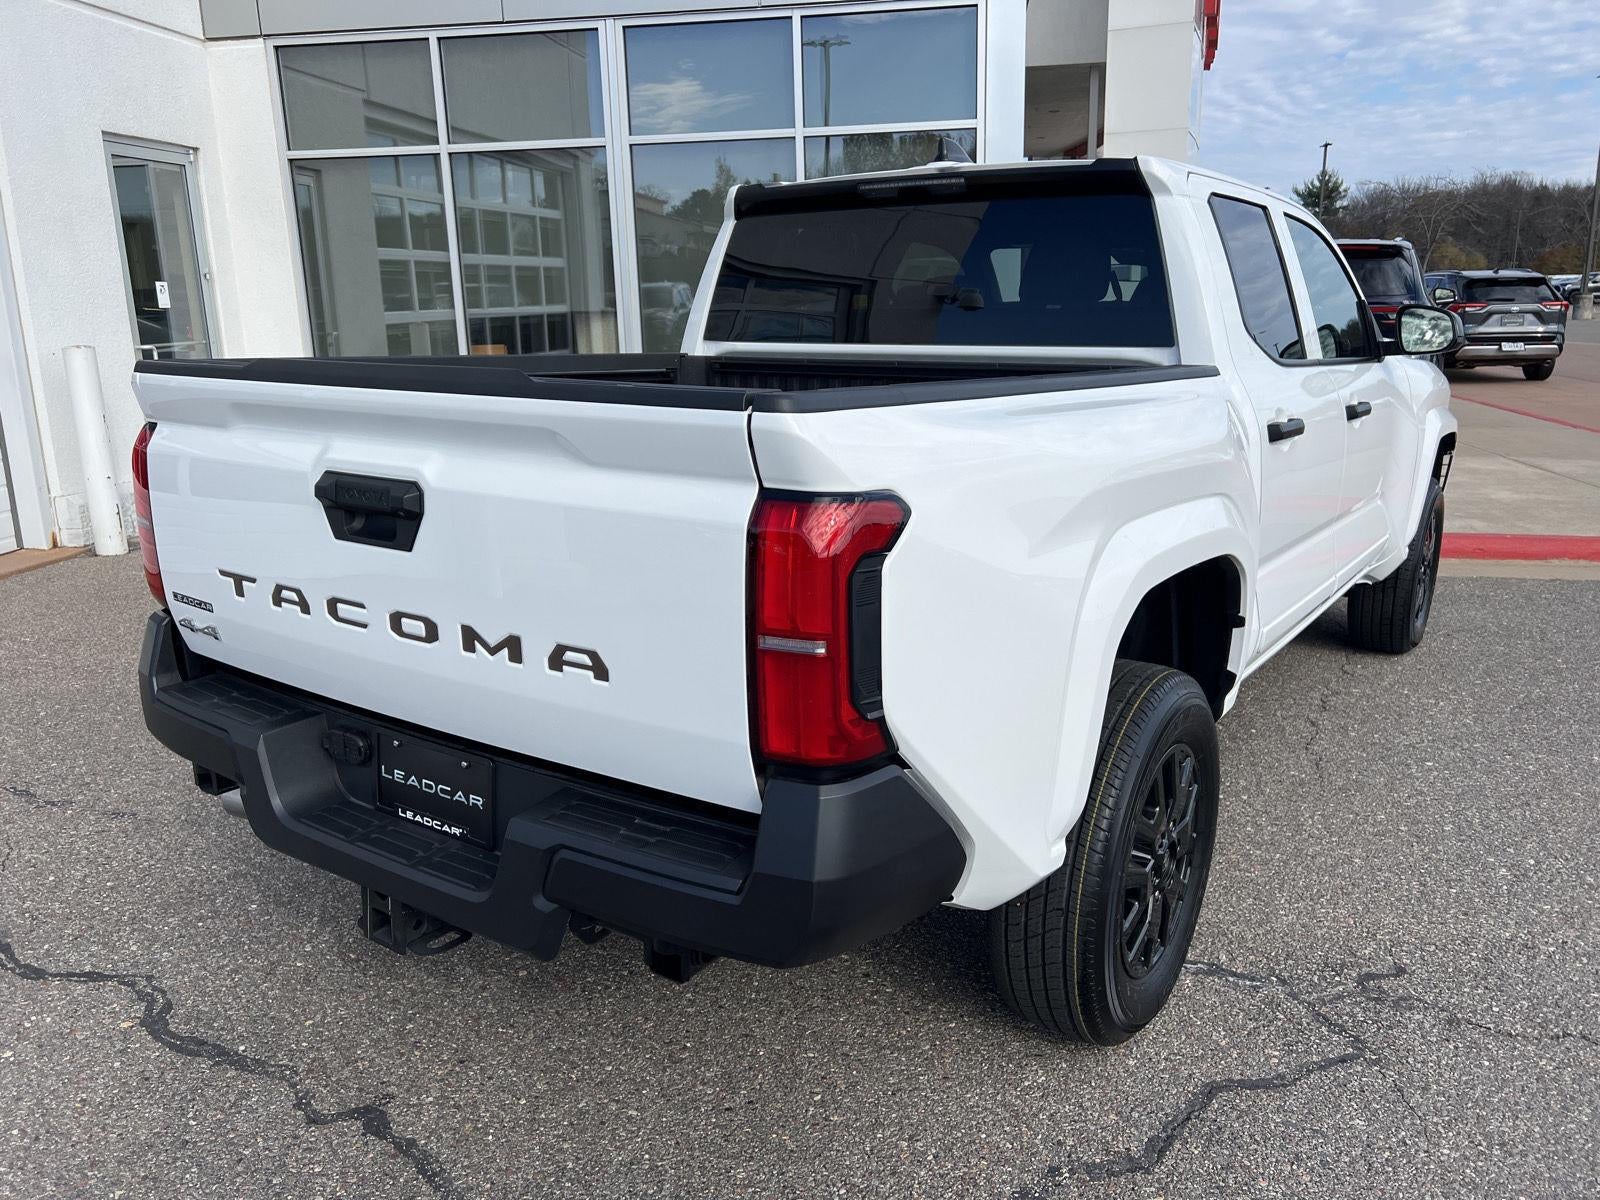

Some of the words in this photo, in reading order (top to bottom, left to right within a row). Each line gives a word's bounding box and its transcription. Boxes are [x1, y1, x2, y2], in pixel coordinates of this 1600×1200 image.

[217, 568, 610, 682] TACOMA
[381, 764, 484, 810] LEADCAR
[398, 808, 461, 837] LEADCAR
